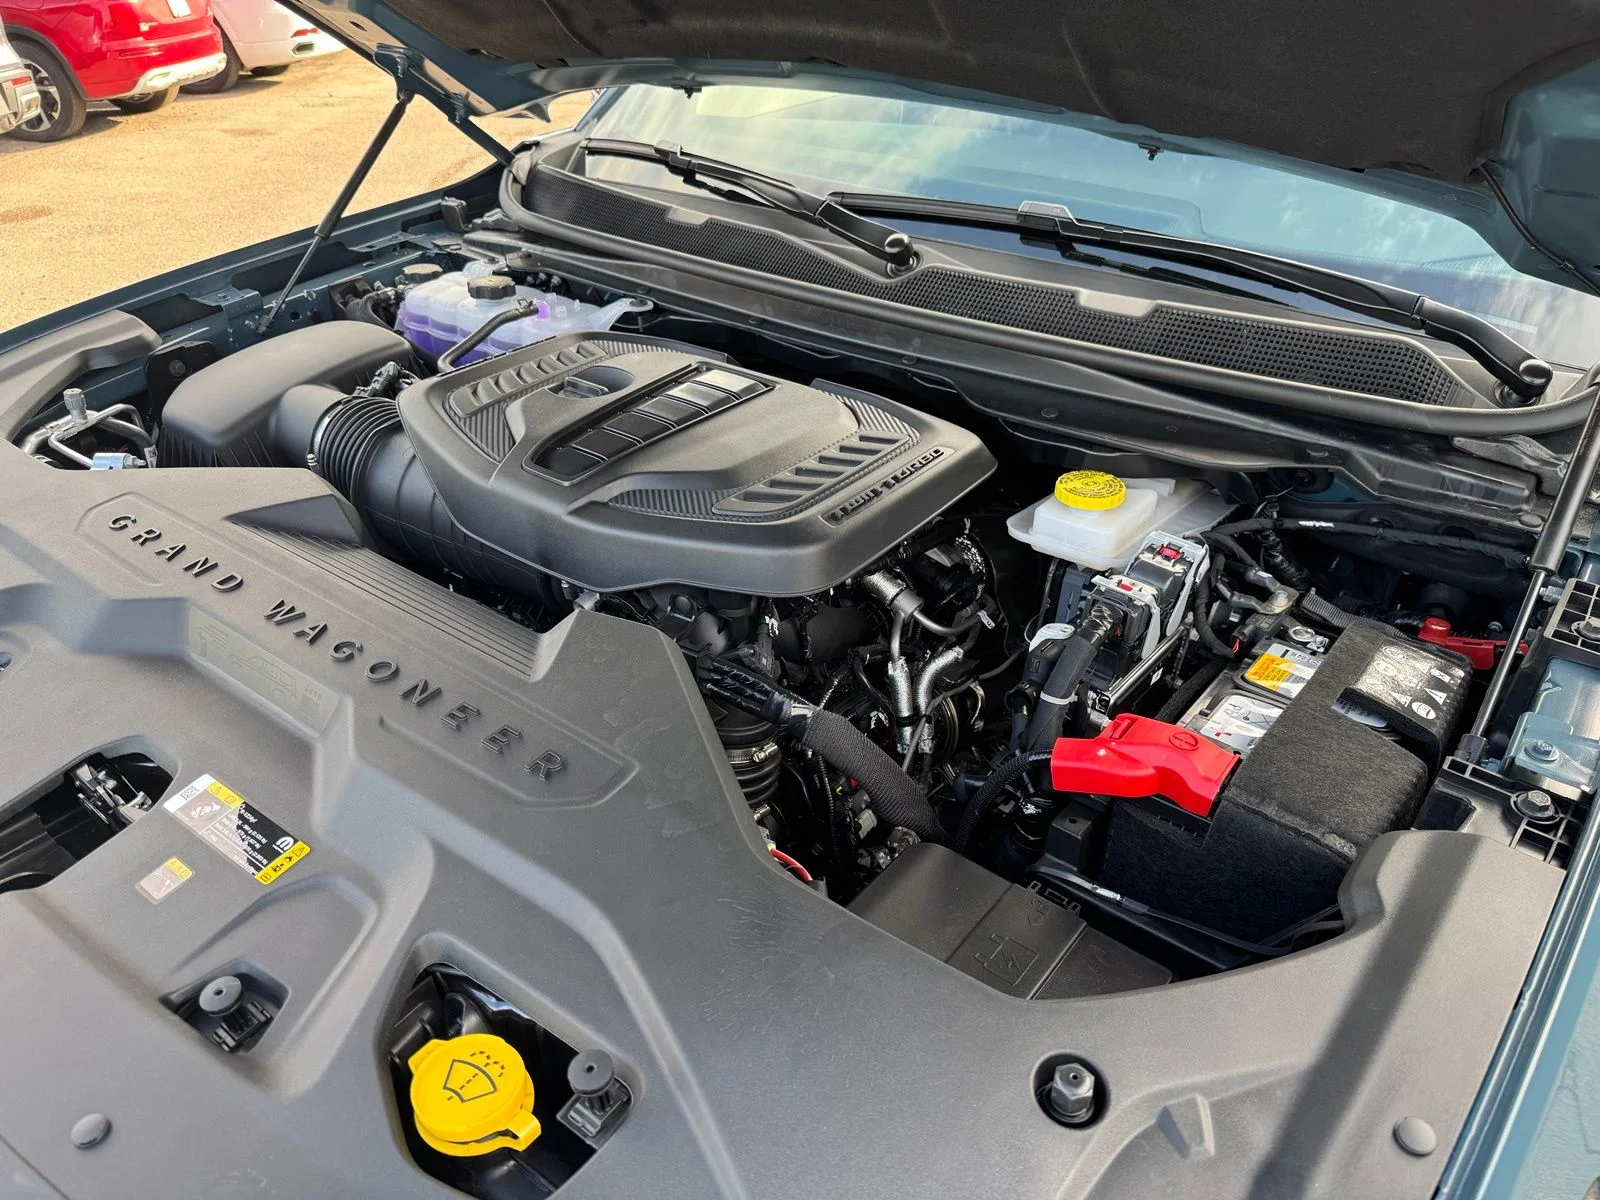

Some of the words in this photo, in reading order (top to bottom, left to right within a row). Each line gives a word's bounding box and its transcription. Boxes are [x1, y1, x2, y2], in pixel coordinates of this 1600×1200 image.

[882, 448, 945, 490] TURBO
[108, 514, 244, 593] GRAND
[263, 599, 568, 782] WAGONEER
